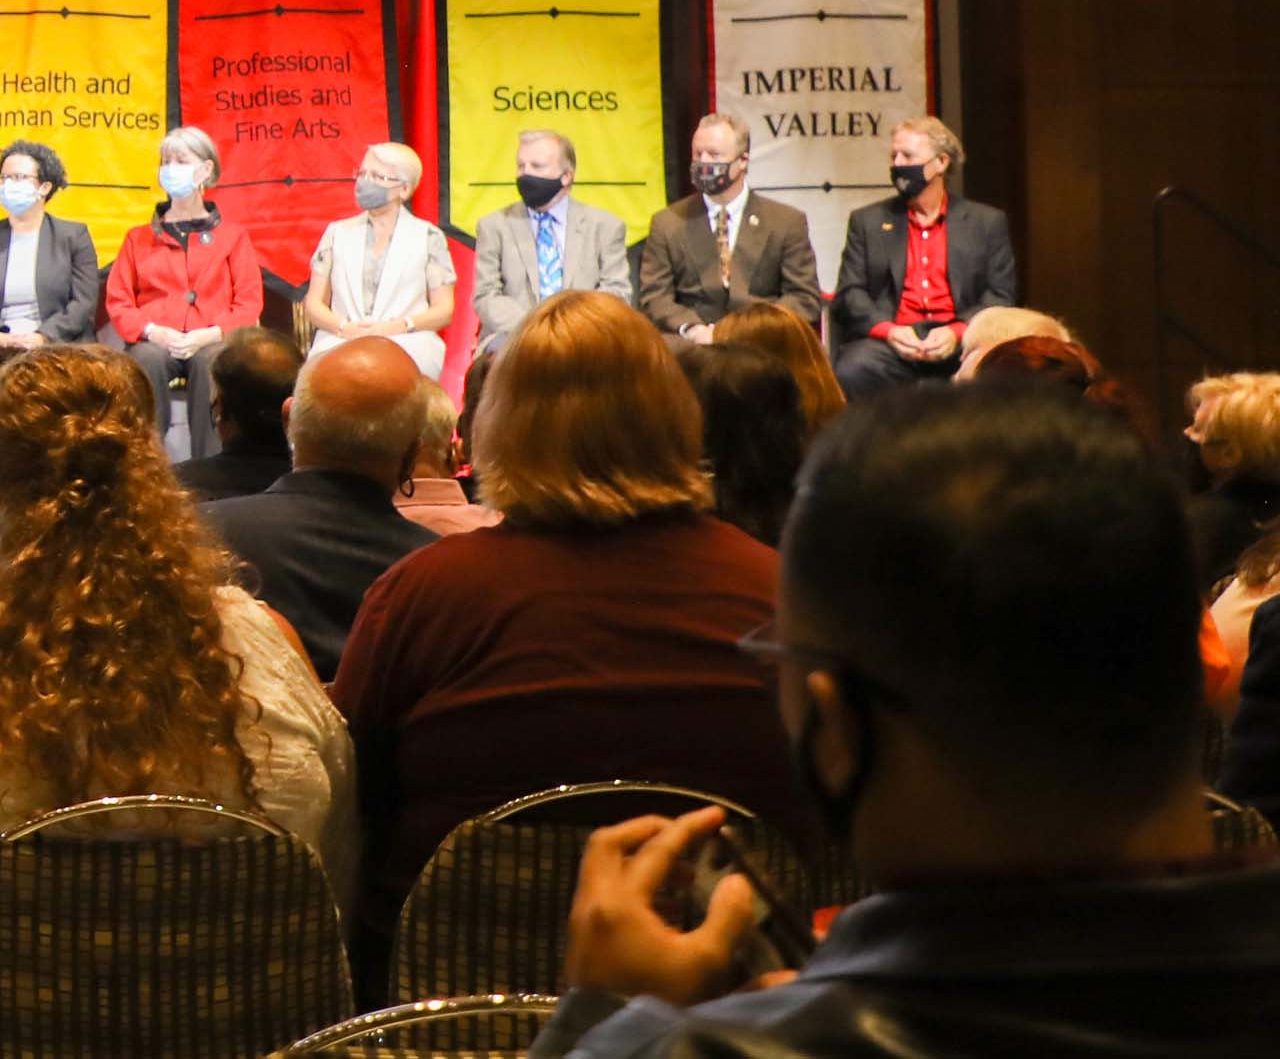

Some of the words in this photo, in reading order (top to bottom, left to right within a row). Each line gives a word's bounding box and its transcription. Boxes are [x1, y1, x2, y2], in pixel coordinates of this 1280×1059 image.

[212, 51, 352, 78] Professional
[2, 71, 77, 95] Health
[86, 72, 131, 95] and
[741, 66, 902, 95] IMPERIAL
[215, 86, 303, 112] Studies
[310, 86, 352, 107] and
[492, 86, 619, 113] Sciences
[63, 107, 160, 131] Services
[235, 120, 285, 143] Fine
[292, 117, 340, 139] Arts
[764, 111, 883, 139] VALLEY
